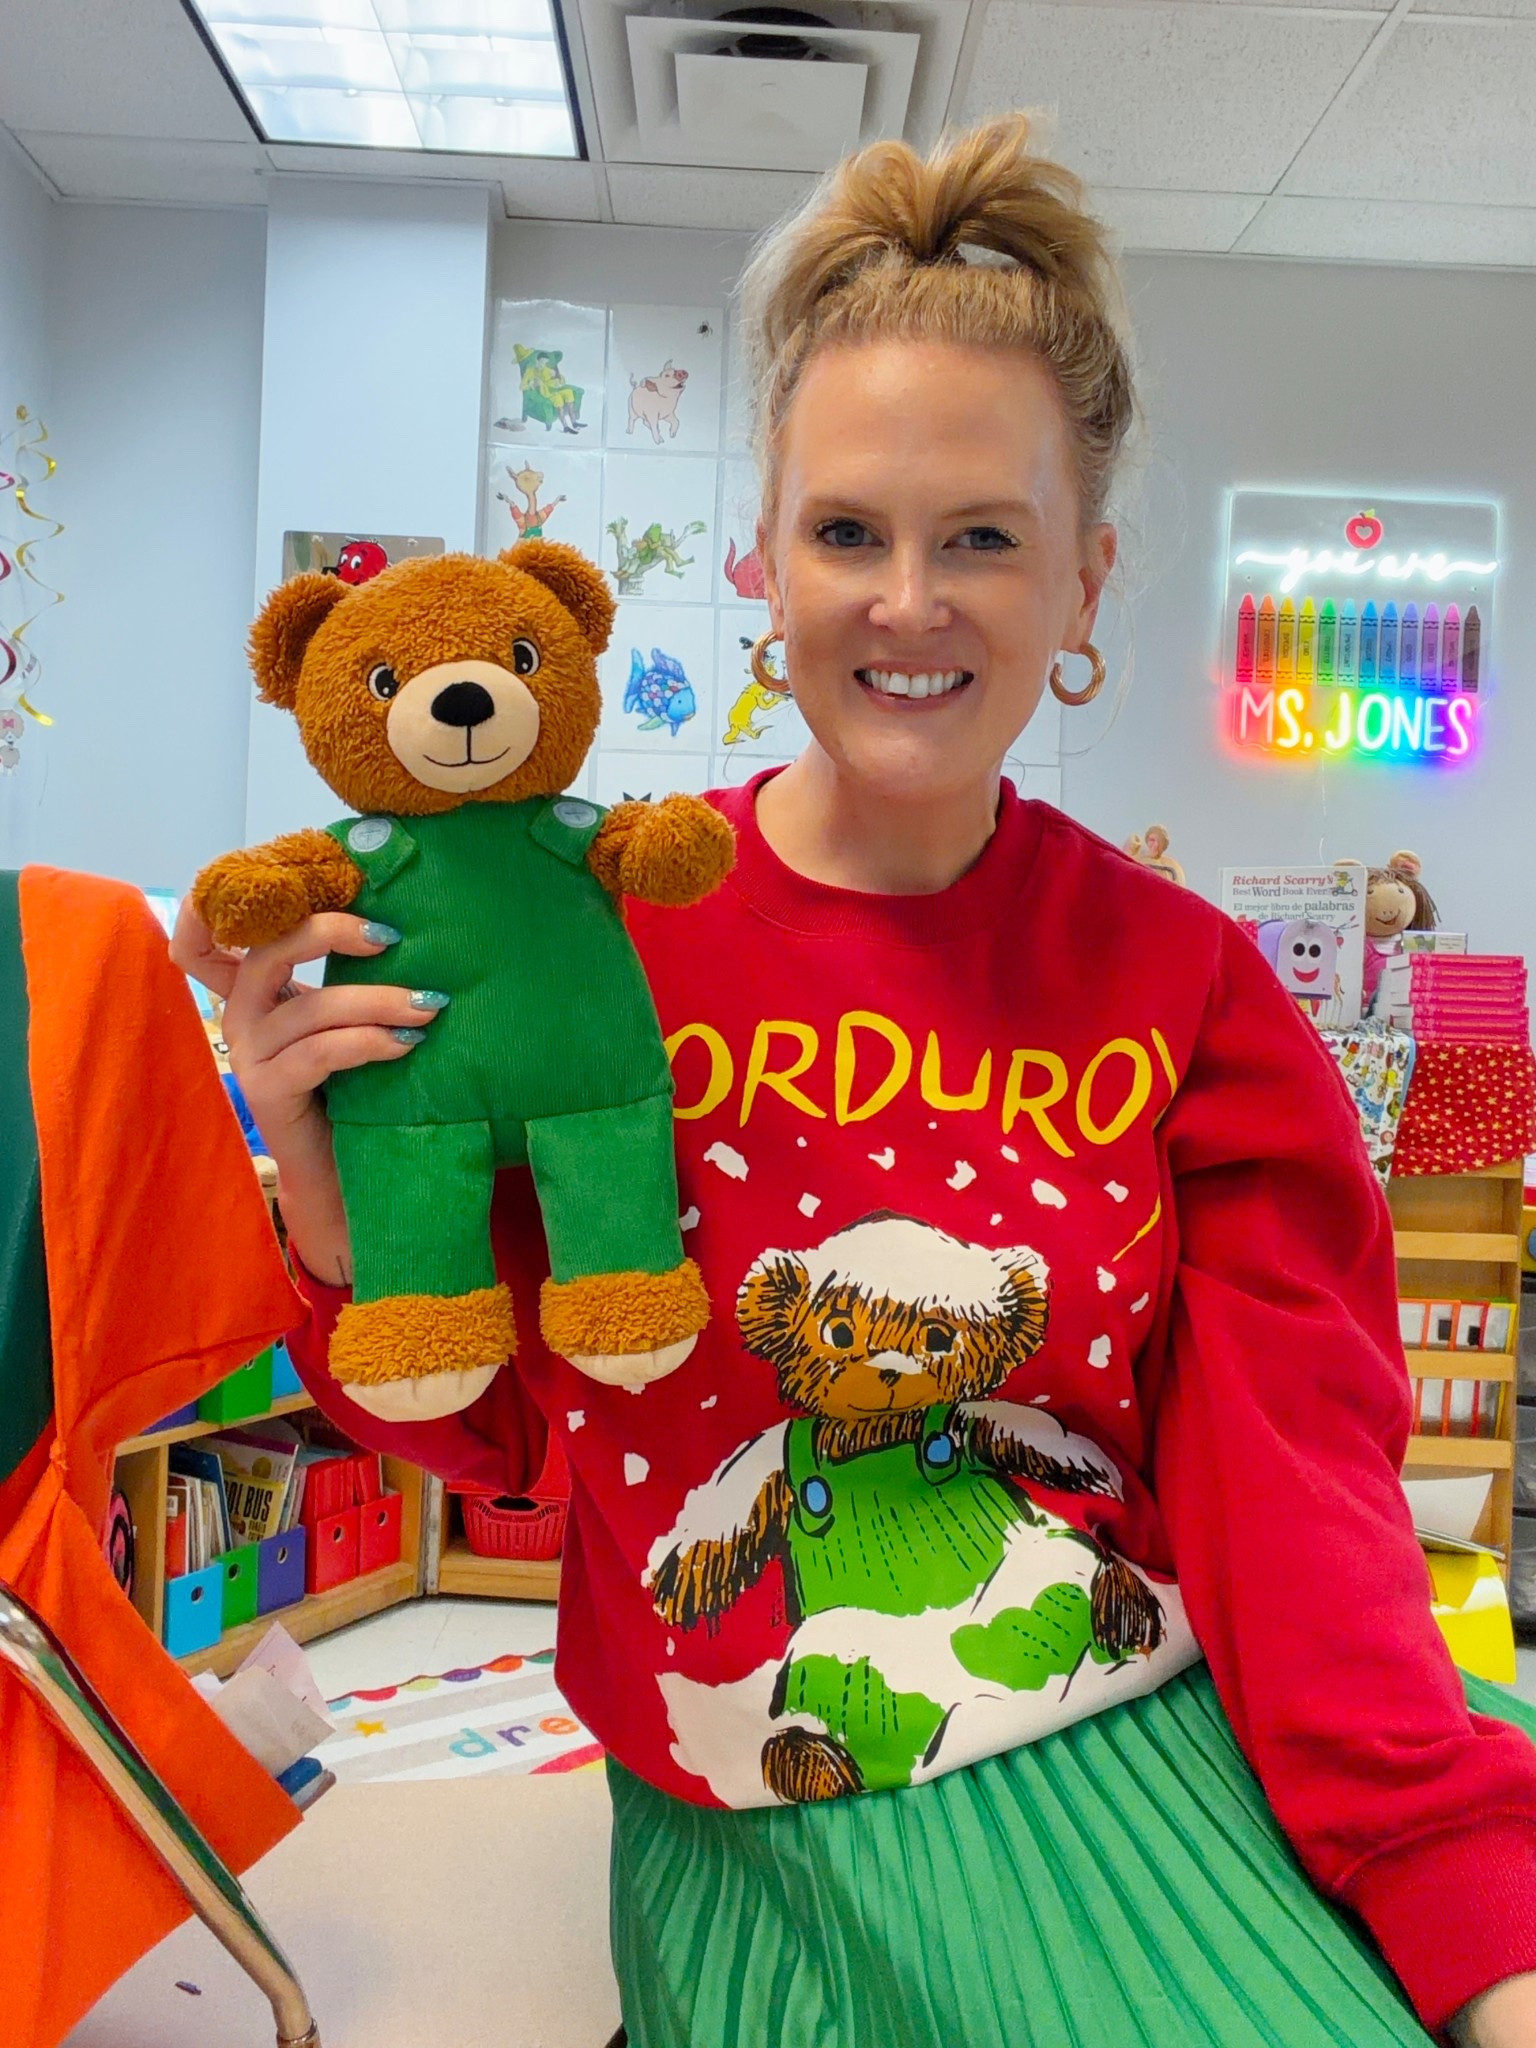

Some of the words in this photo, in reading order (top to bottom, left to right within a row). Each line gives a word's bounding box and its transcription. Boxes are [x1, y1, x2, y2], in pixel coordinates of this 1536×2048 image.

[1236, 549, 1375, 593] you
[1378, 552, 1497, 581] are
[1239, 687, 1314, 748] MS.
[1325, 691, 1472, 755] JONES
[1232, 875, 1281, 886] Richard
[1283, 874, 1334, 887] Scarry's
[1232, 887, 1251, 896] Best
[1252, 886, 1281, 897] Word
[1282, 887, 1304, 896] Book
[1233, 903, 1243, 911] El
[1244, 902, 1269, 913] mejor
[1270, 902, 1290, 911] libro
[1291, 902, 1302, 911] de
[1304, 900, 1355, 914] palabras
[1258, 912, 1269, 920] de
[664, 1010, 1177, 1262] ORDURO
[243, 1484, 273, 1522] BUS
